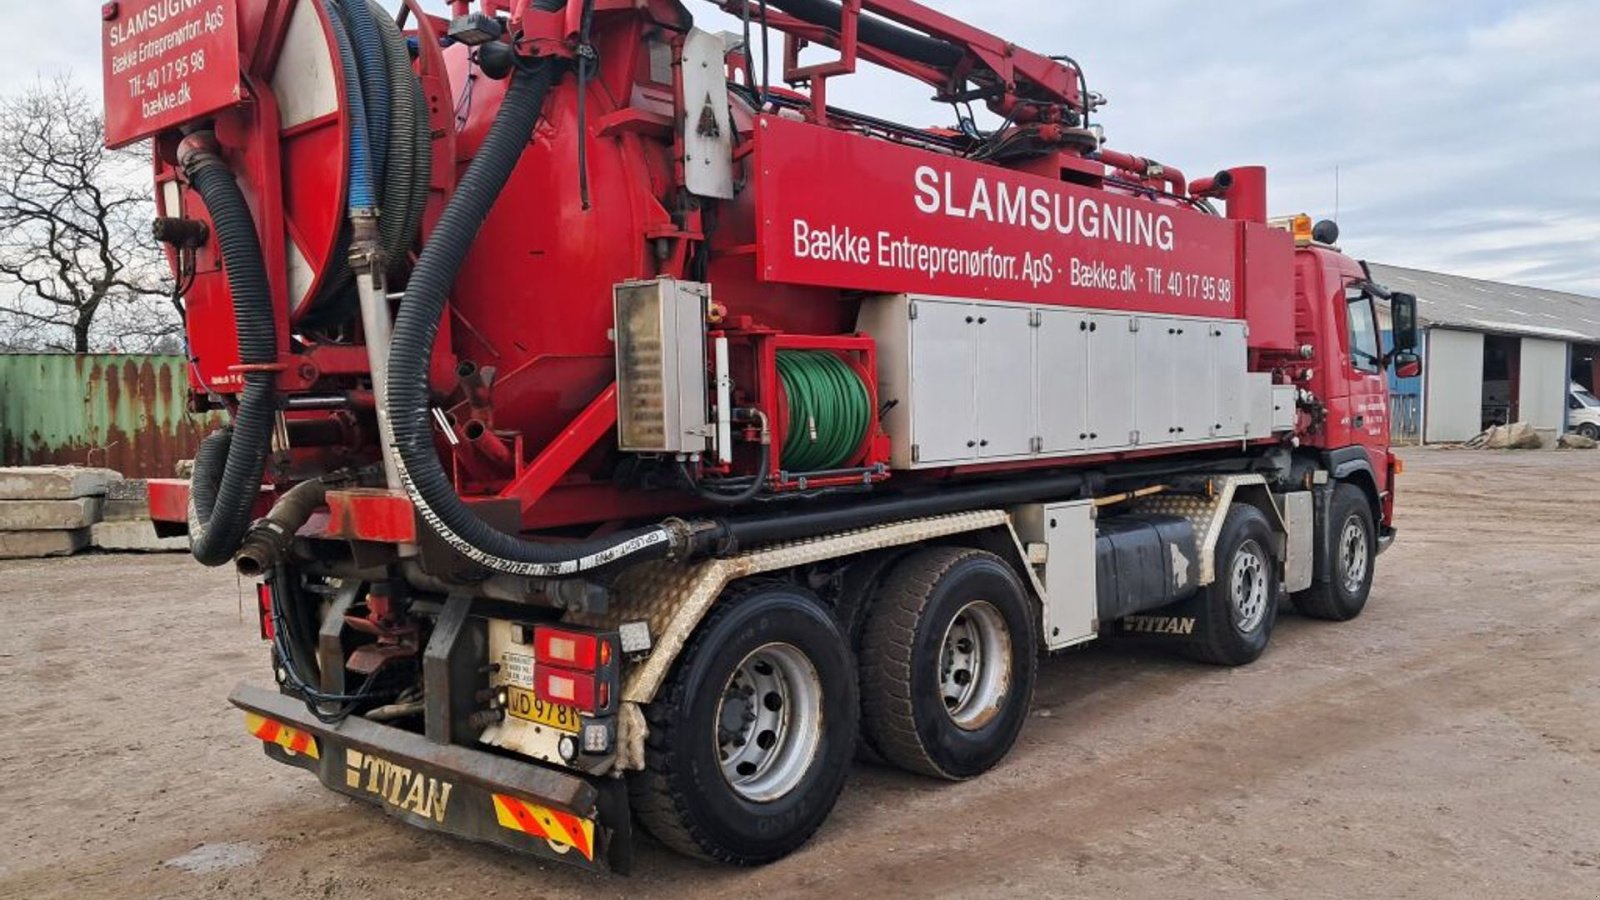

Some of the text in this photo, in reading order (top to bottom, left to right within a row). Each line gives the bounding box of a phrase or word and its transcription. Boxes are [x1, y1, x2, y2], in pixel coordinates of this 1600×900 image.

[204, 5, 224, 34] ApS
[147, 68, 159, 90] 40
[161, 62, 173, 84] 17
[175, 56, 189, 79] 95
[190, 49, 205, 73] 98
[142, 82, 192, 118] bække.dk
[914, 165, 1174, 251] SLAMSUGNING
[793, 219, 870, 264] Bække
[878, 231, 1019, 280] Entreprenørforr.
[1022, 251, 1053, 288] ApS
[1070, 257, 1136, 291] Bække.dk
[1167, 272, 1182, 297] 40
[1186, 274, 1199, 298] 17
[1201, 276, 1216, 300] 95
[1218, 279, 1231, 302] 98
[1135, 615, 1195, 634] TITAN
[362, 756, 453, 823] TITAN
